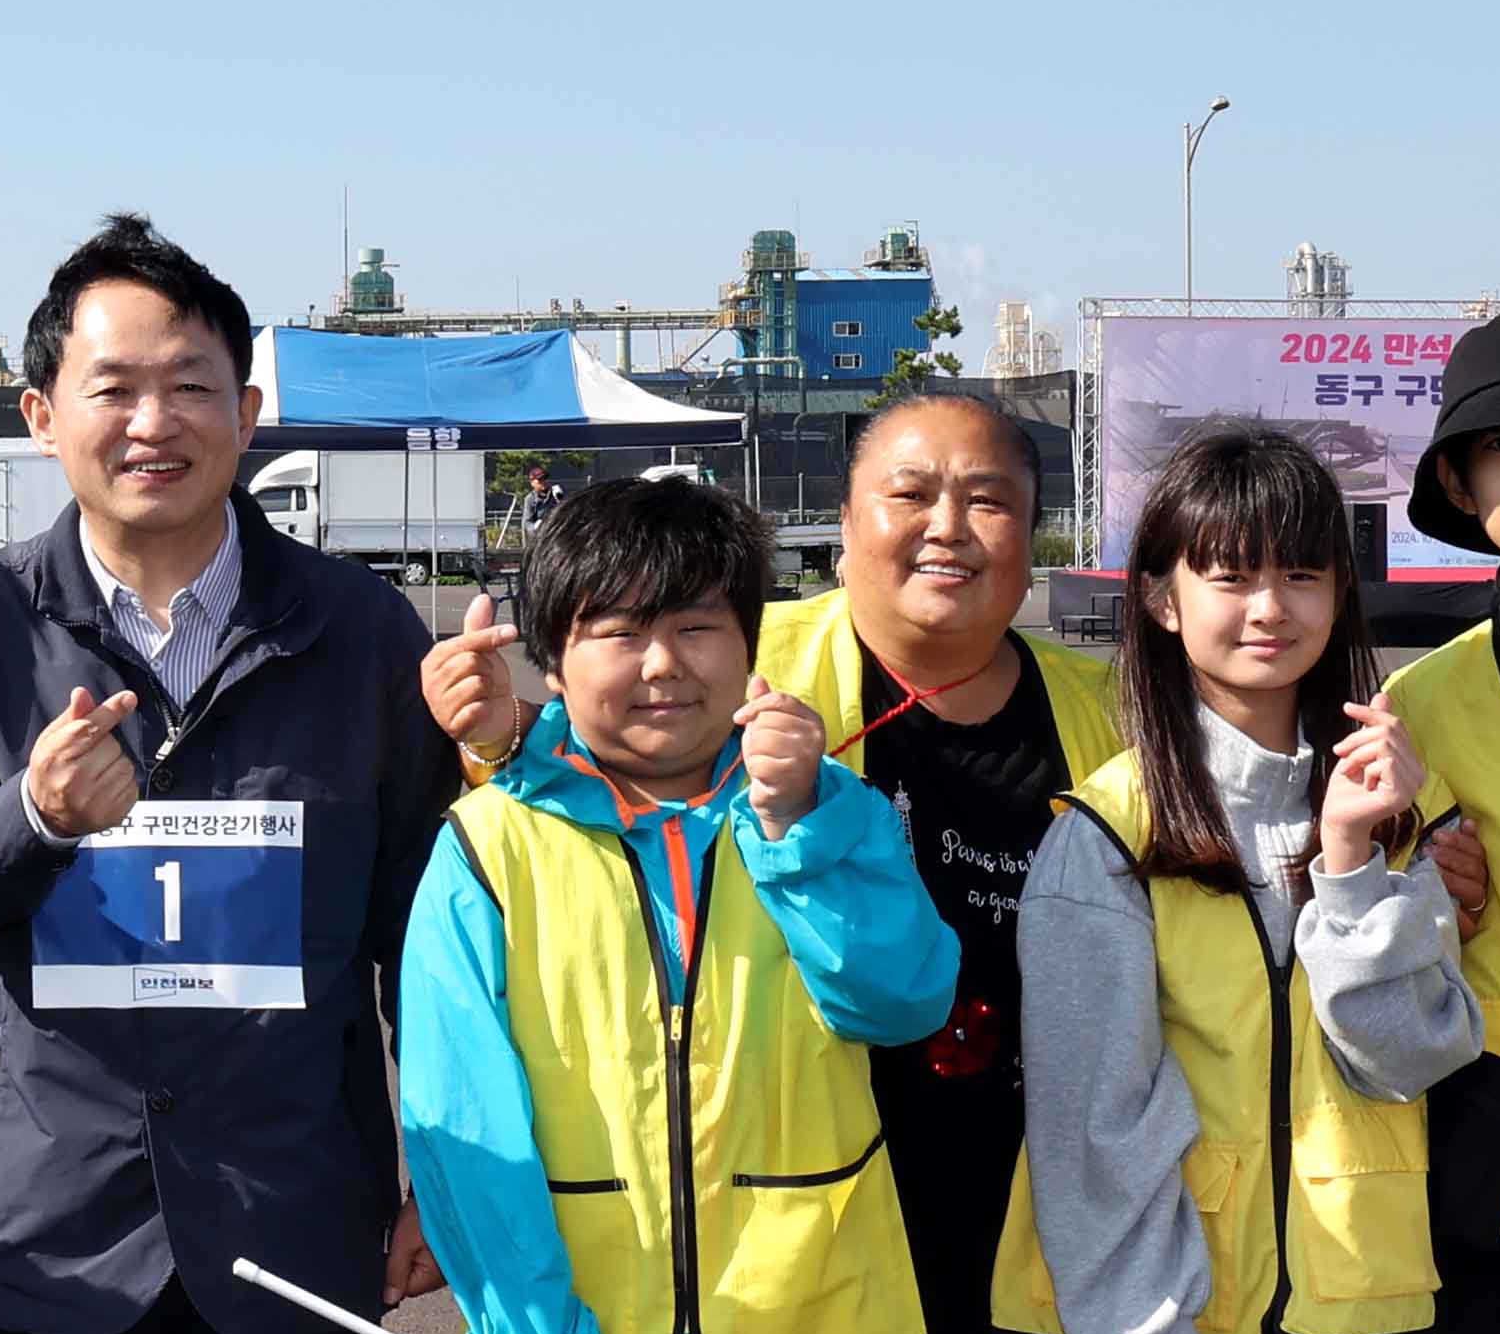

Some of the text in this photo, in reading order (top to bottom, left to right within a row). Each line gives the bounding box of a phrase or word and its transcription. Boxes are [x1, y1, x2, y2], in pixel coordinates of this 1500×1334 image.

[1279, 333, 1372, 364] 2024
[1315, 374, 1384, 406] 동구
[406, 427, 461, 451] 음향
[142, 815, 297, 836] 구민건강걷기행사
[942, 828, 996, 873] Paris
[154, 861, 182, 942] 1
